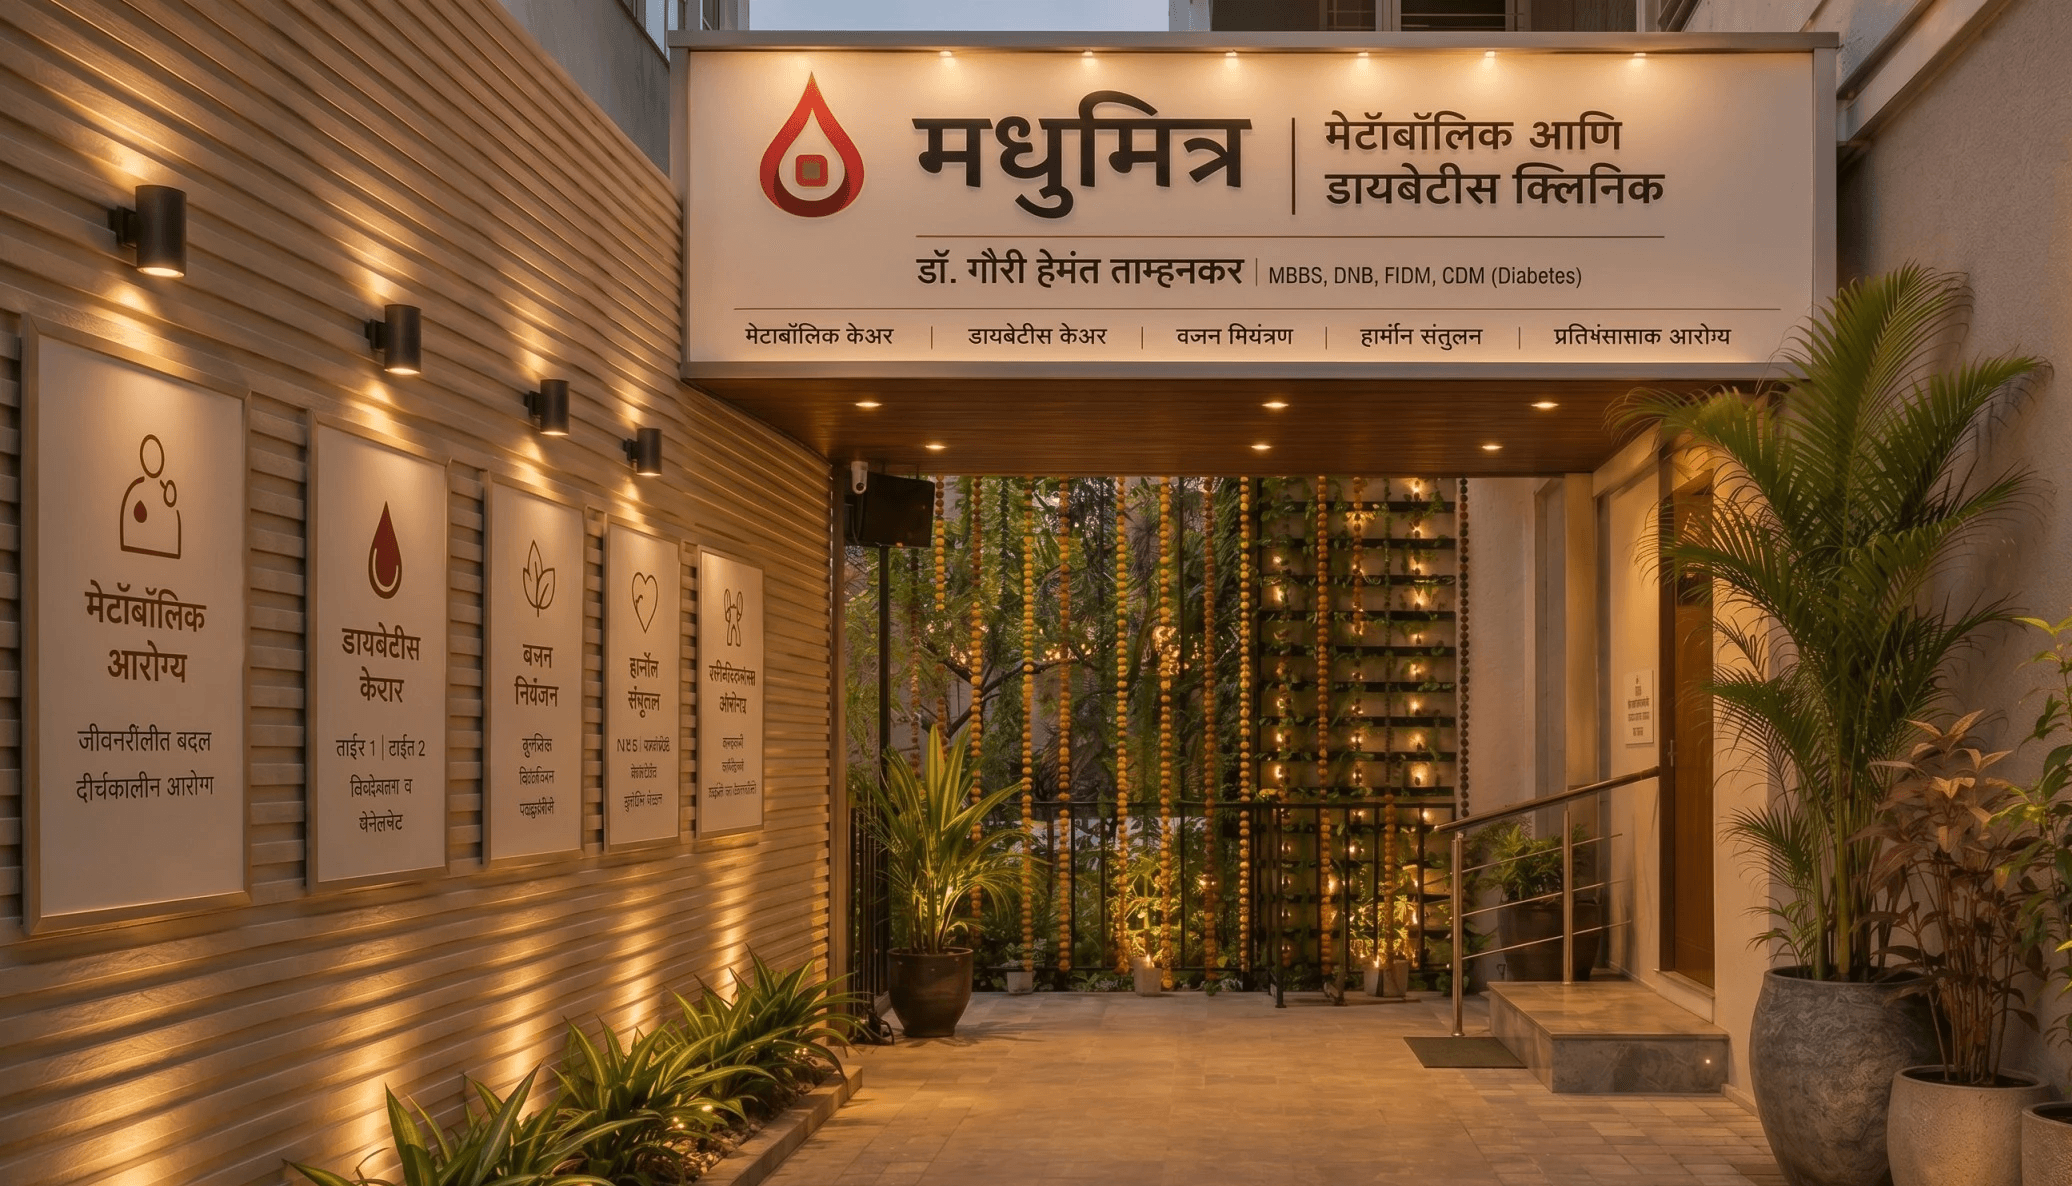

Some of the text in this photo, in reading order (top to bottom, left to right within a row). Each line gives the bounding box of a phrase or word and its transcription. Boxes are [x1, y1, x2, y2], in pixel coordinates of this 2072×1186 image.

[1325, 110, 1622, 150] मेटॉबॉलिक आणि
[912, 91, 1252, 219] मधुमित्र
[1325, 162, 1665, 204] डायबेटीस क्लिनिक
[916, 248, 1245, 288] डॉ. गौरी हेमंत ताम्हनकर
[1270, 267, 1581, 288] MBBS, DNB, FIDM, CDM (Diabetes)
[745, 323, 894, 344] मेटाबॉलिक केअर
[968, 323, 1107, 344] डायबेटीस केअर
[1176, 323, 1294, 344] वजन मियंत्रण
[1420, 324, 1483, 350] संतुलन
[1670, 323, 1732, 344] आरोग्य
[85, 579, 206, 632] मेटॉबॉलिक
[342, 622, 421, 660] डायबेटीस
[108, 640, 187, 683] आरोग्य
[360, 666, 404, 702] केरार
[176, 732, 212, 753] बदल
[370, 740, 374, 756] 1
[419, 740, 425, 756] 2
